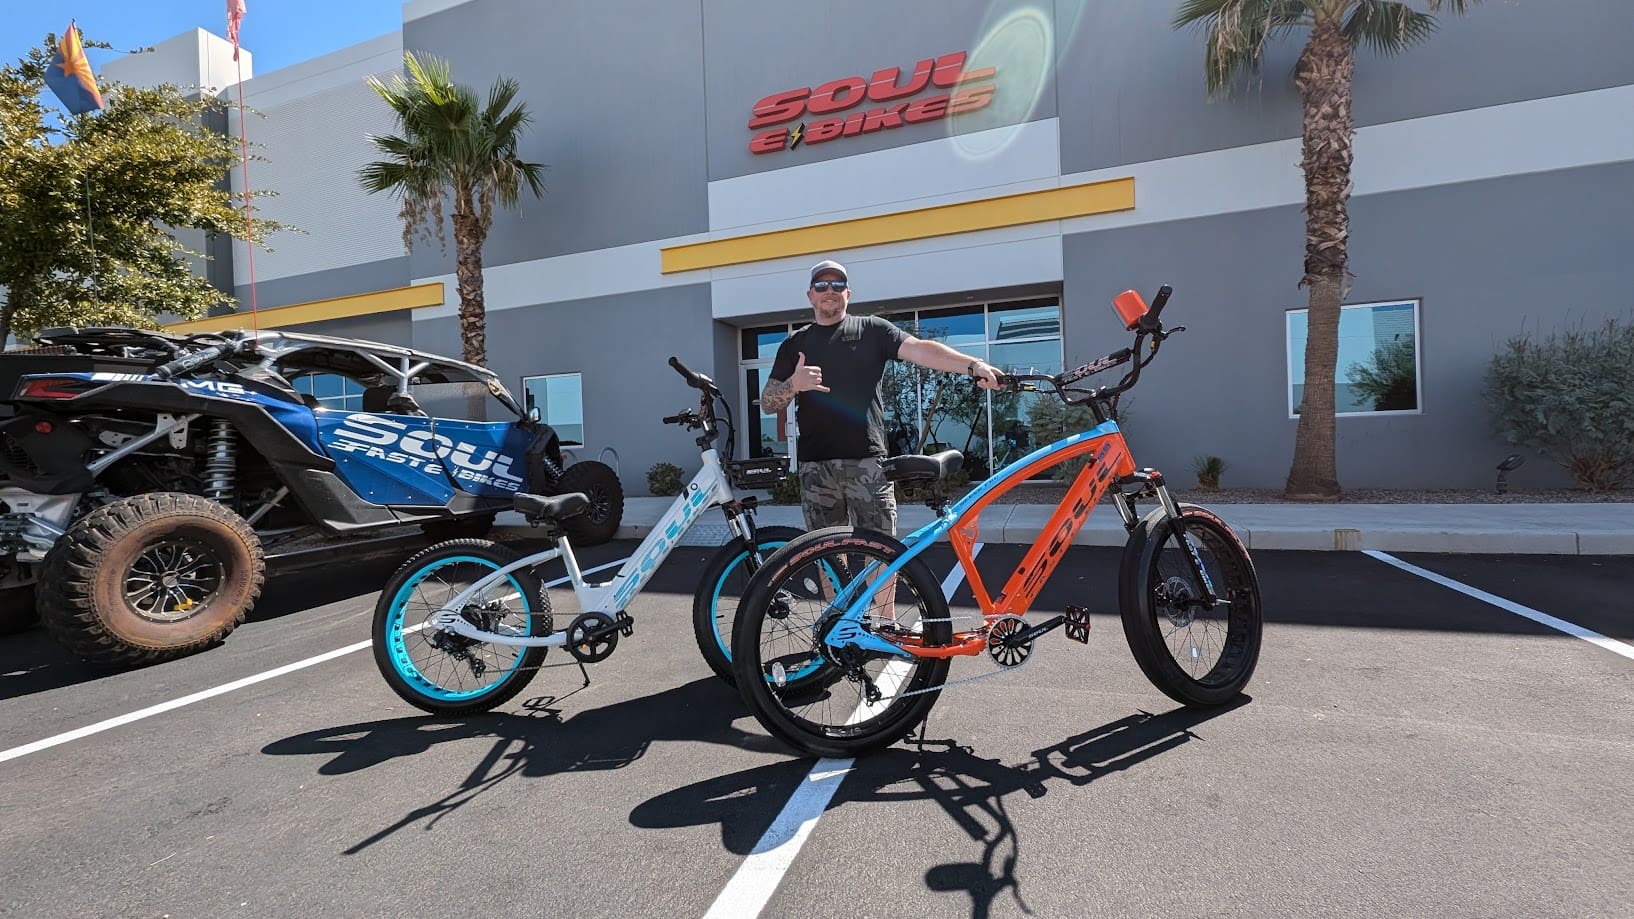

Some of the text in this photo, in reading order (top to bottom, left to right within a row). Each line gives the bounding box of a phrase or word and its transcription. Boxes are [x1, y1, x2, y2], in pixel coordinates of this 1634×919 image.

[748, 51, 996, 129] SOUL
[749, 84, 996, 155] E BIKES
[328, 439, 521, 492] FAST E BIKES
[333, 413, 524, 483] SOUL
[614, 480, 718, 605] SOUL
[1024, 451, 1122, 599] SOUL
